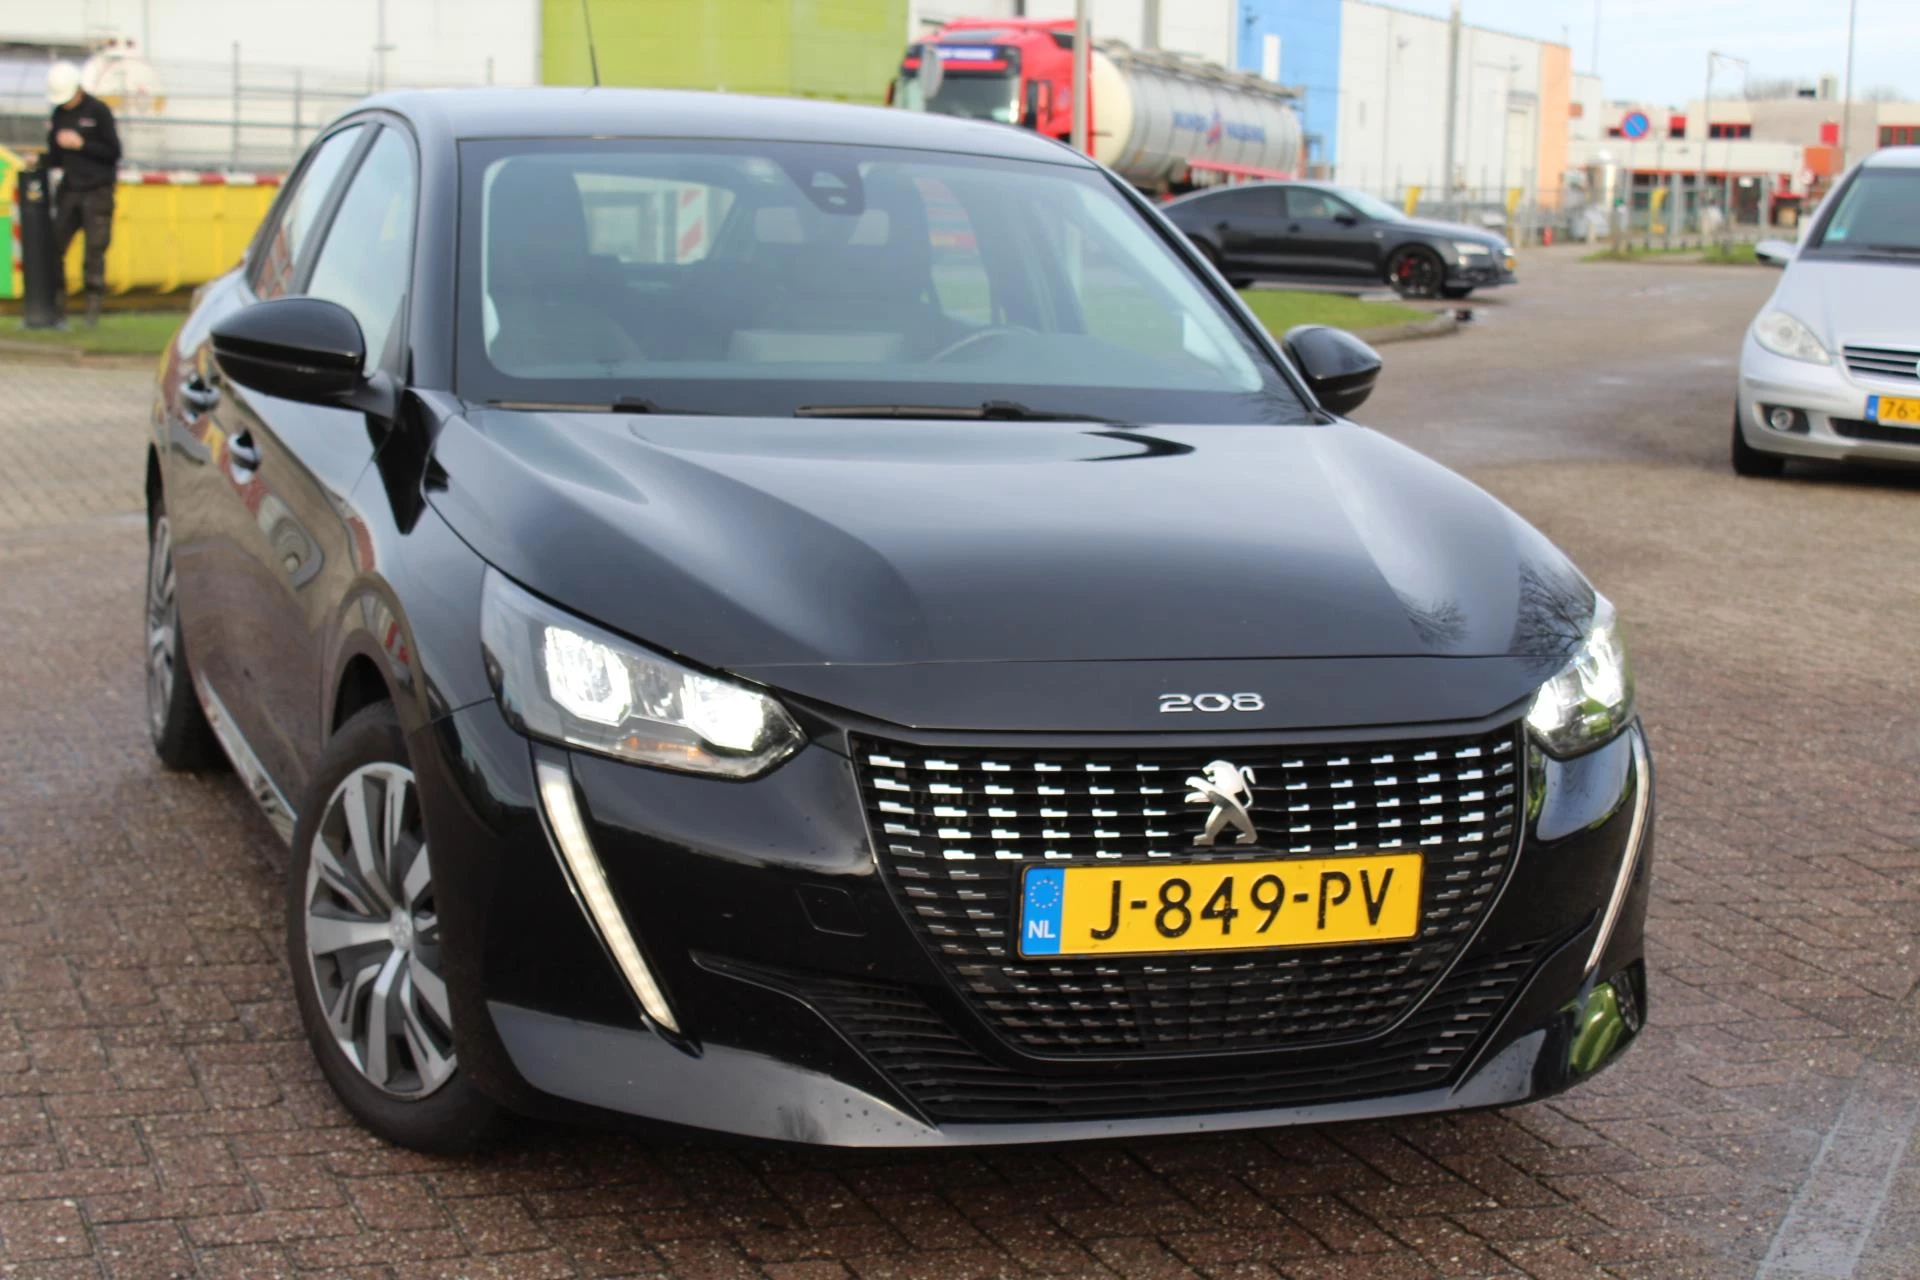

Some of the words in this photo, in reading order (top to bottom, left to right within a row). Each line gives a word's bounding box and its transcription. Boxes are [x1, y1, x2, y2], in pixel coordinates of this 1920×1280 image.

[1159, 692, 1265, 713] 208
[1090, 867, 1394, 941] J-849-PV
[1028, 919, 1056, 940] NL
